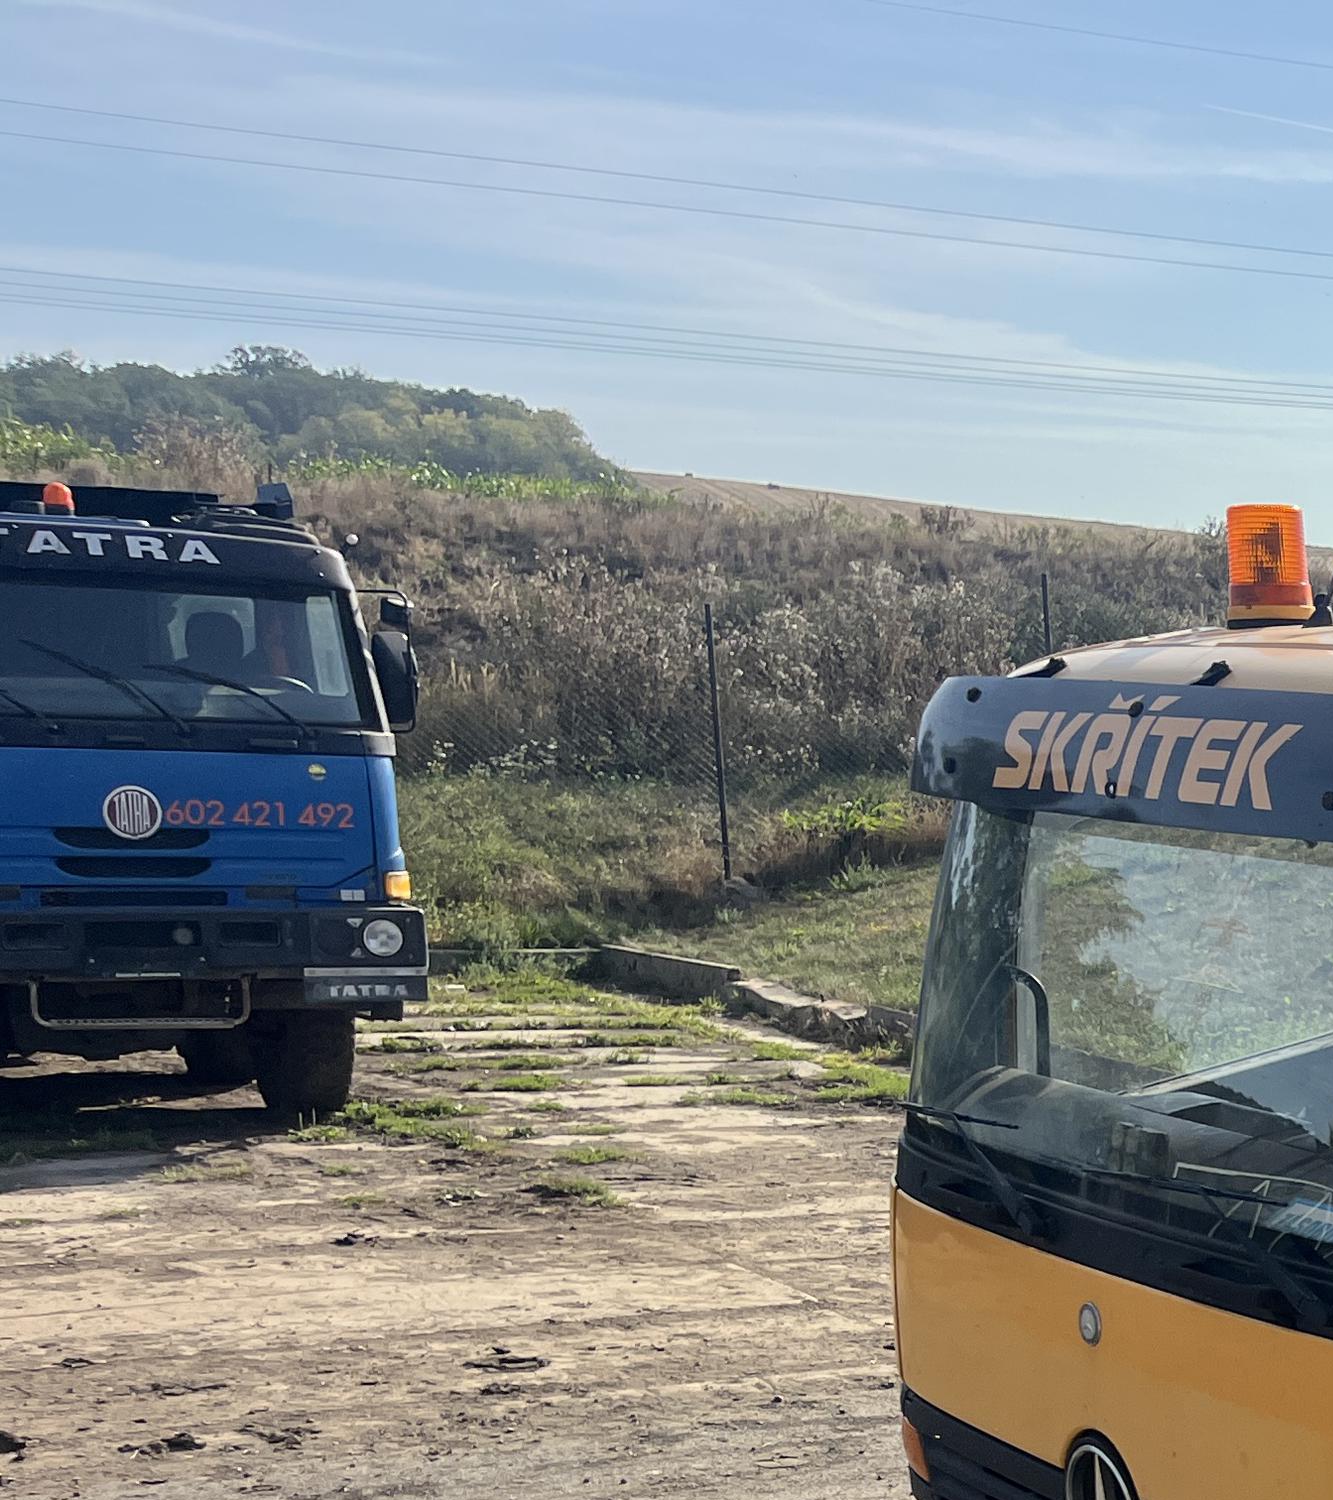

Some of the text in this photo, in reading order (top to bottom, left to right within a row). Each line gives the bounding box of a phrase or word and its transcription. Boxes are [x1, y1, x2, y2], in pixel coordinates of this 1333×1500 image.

[0, 528, 221, 565] ATRA
[992, 693, 1304, 811] SKŘÍTEK
[113, 791, 151, 834] TATRA
[164, 800, 355, 828] 602 421 492
[329, 984, 409, 998] TATRA
